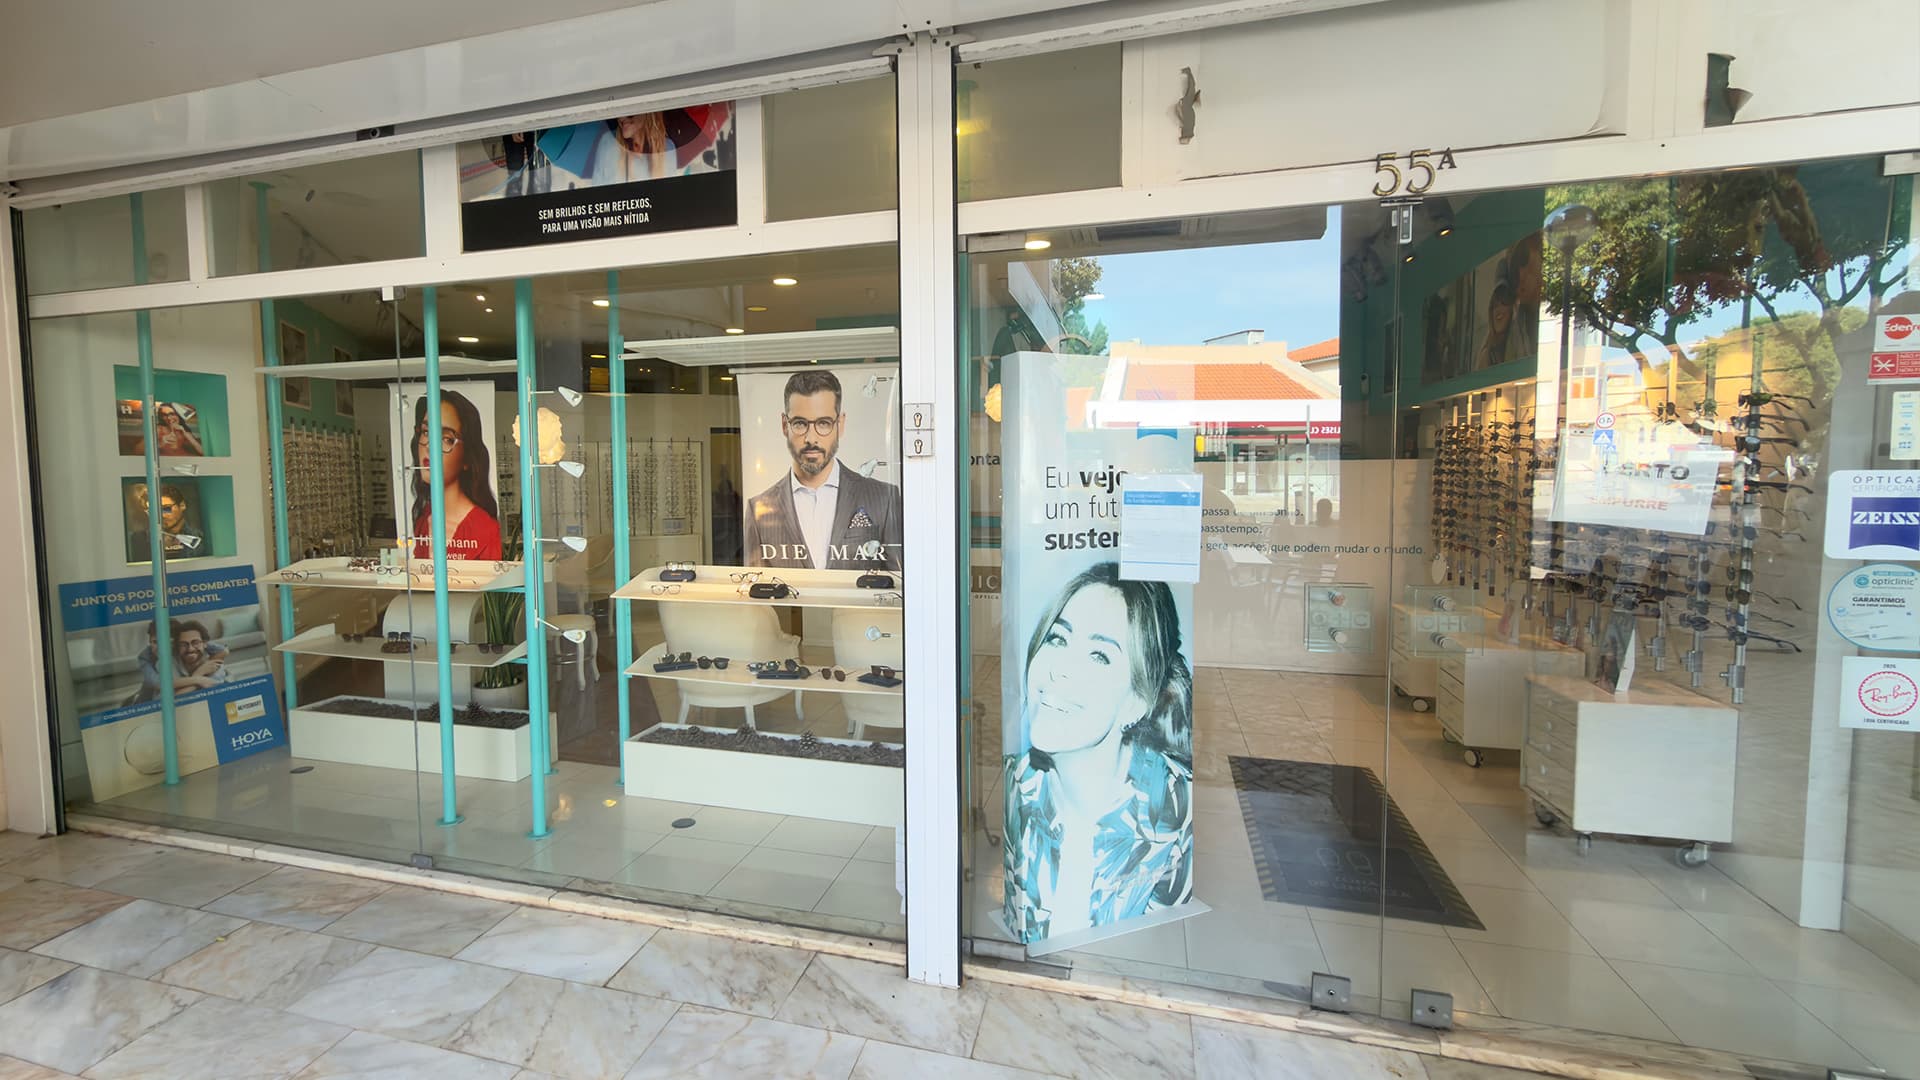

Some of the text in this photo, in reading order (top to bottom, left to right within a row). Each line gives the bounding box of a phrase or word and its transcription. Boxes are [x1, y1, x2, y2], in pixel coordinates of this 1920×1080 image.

[538, 197, 652, 220] SEM BRILHOS E SEM REFLEXOS,
[542, 211, 650, 234] PARA UMA VISÃO MAIS NÍTIDA
[1045, 466, 1070, 489] Eu
[1044, 501, 1079, 520] um
[1202, 508, 1230, 518] passa
[1852, 511, 1920, 525] ZEISS
[760, 543, 808, 560] DIE
[1206, 542, 1228, 552] gera
[1271, 545, 1290, 556] que
[1334, 543, 1369, 554] mudar
[1373, 546, 1380, 554] o
[71, 577, 250, 608] JUNTOS PODMOS COMBATER
[1852, 596, 1906, 604] GARANTIMOS
[113, 593, 222, 616] A MIOP INFANTIL
[231, 728, 273, 748] HOYA
